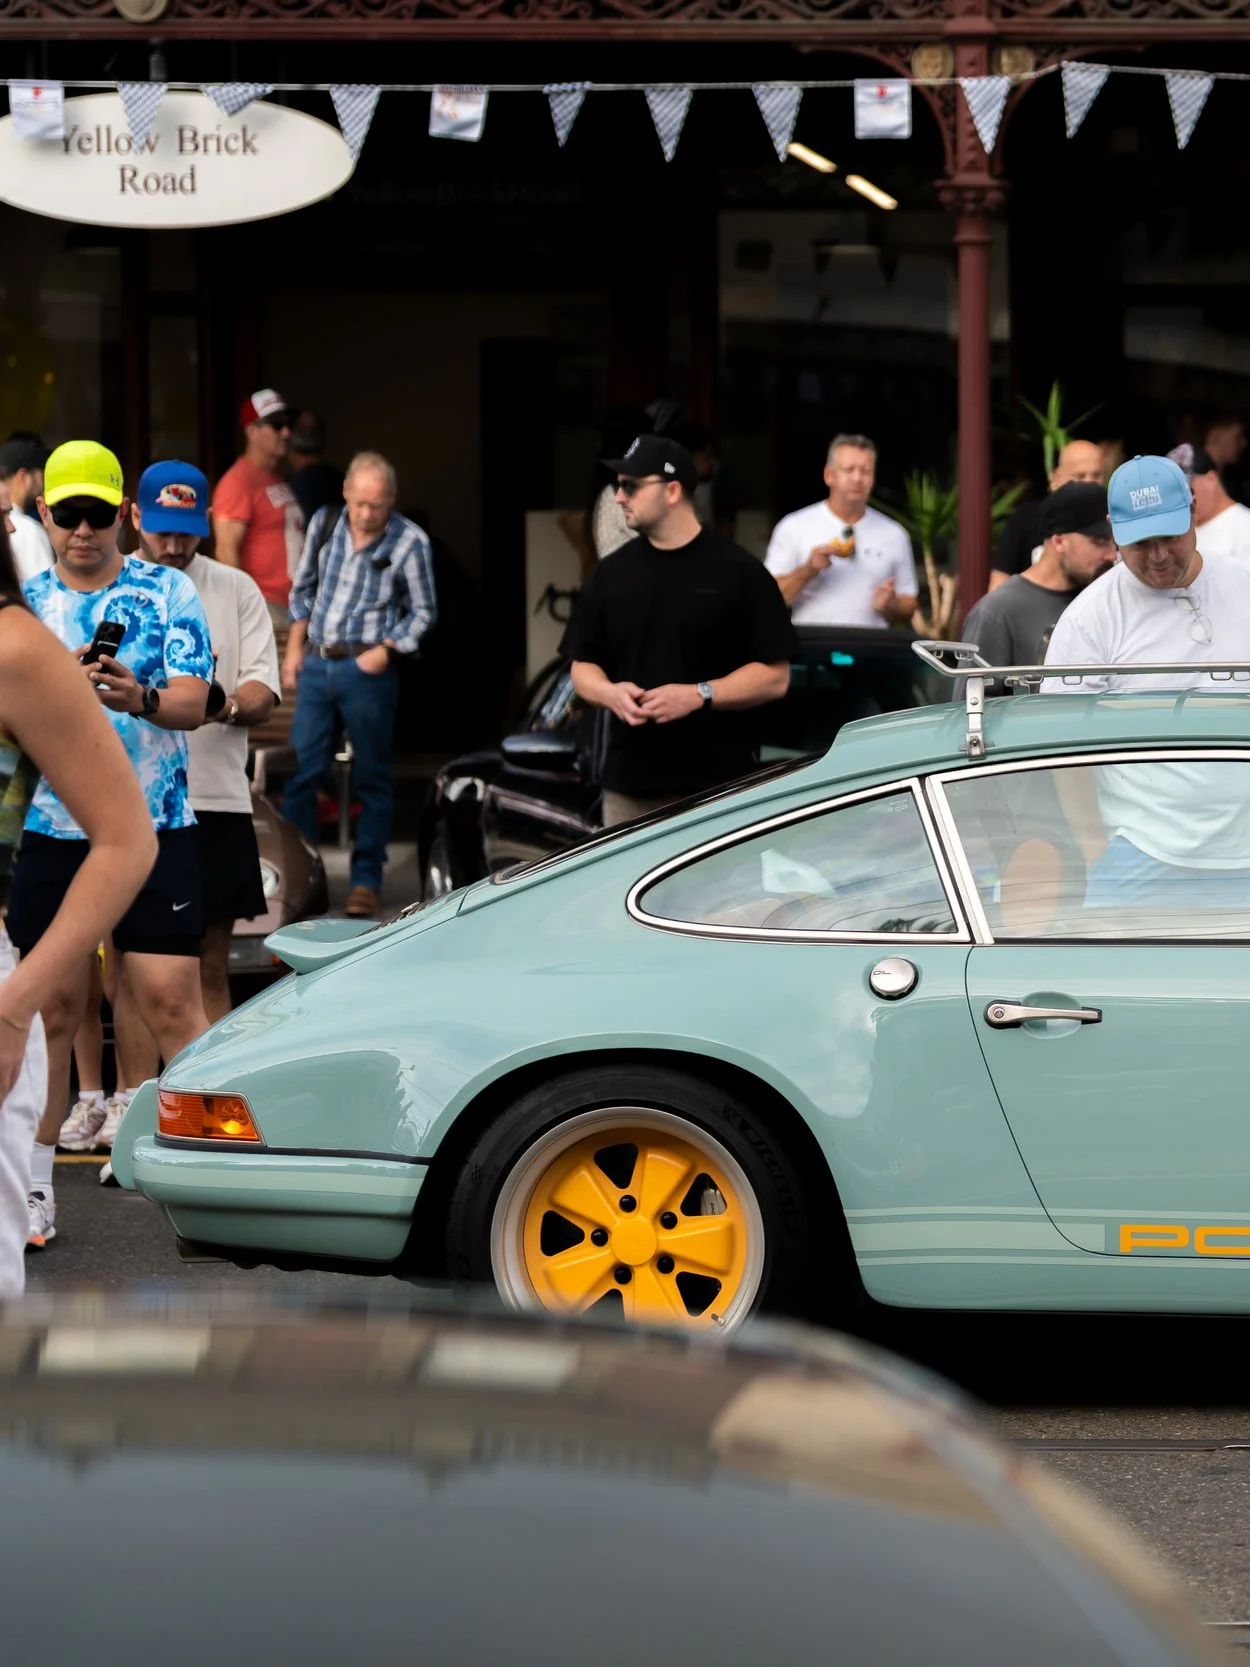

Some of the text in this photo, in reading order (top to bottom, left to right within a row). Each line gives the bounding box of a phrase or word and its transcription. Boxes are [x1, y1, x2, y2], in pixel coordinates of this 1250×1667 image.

[178, 124, 260, 156] Brick
[120, 164, 198, 196] Road
[1129, 484, 1160, 501] DUBAI
